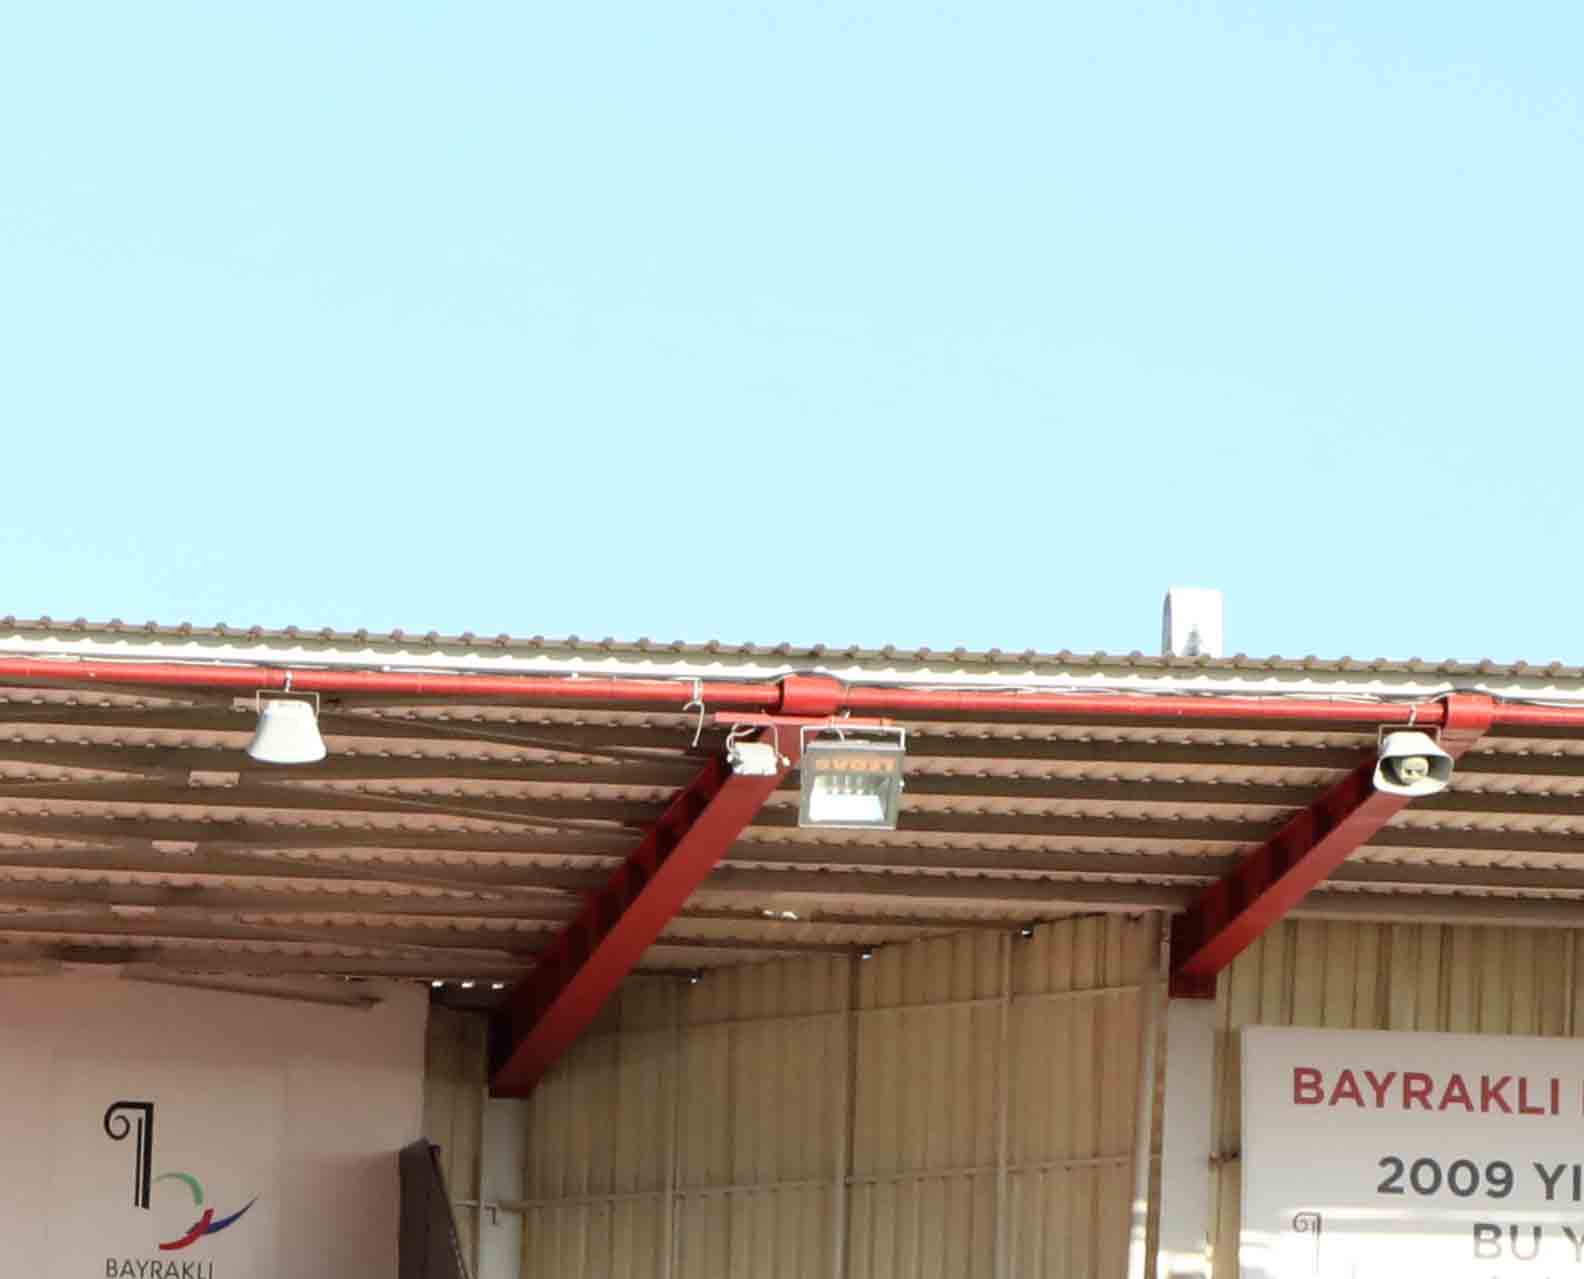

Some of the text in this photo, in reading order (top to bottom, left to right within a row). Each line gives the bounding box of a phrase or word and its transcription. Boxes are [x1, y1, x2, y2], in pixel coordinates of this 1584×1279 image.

[1292, 1067, 1560, 1116] BAYRAKLI
[1377, 1156, 1514, 1198] 2009
[1473, 1222, 1543, 1262] BU
